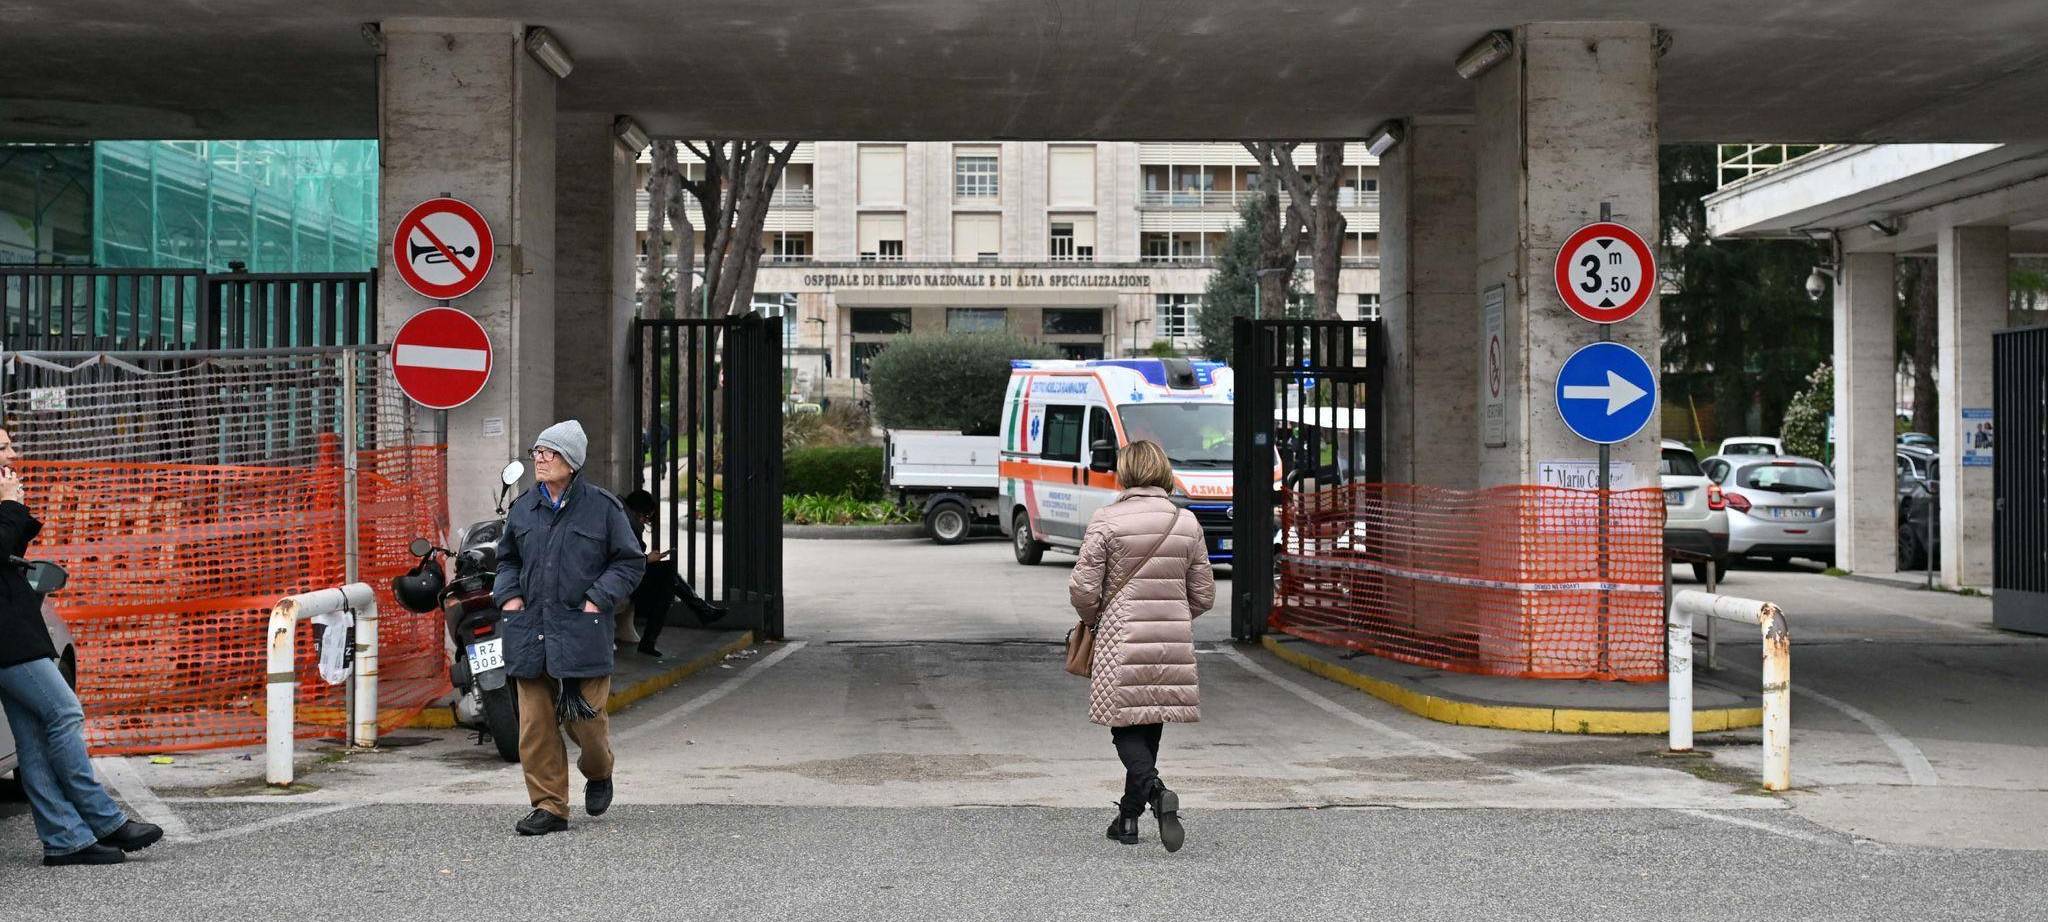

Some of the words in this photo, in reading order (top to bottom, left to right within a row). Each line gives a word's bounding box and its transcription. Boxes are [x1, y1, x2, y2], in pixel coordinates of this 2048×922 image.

[1609, 252, 1622, 265] m
[804, 274, 860, 288] OSPEDALE
[863, 274, 875, 287] DI
[878, 274, 921, 287] RILIEVO
[924, 274, 985, 287] NAZIONALE
[989, 274, 997, 288] E
[1000, 274, 1012, 288] DI
[1016, 274, 1044, 288] ALTA
[1049, 274, 1152, 288] SPECIALIZZAZIONE
[1558, 469, 1585, 488] Mario
[479, 643, 496, 655] RZ
